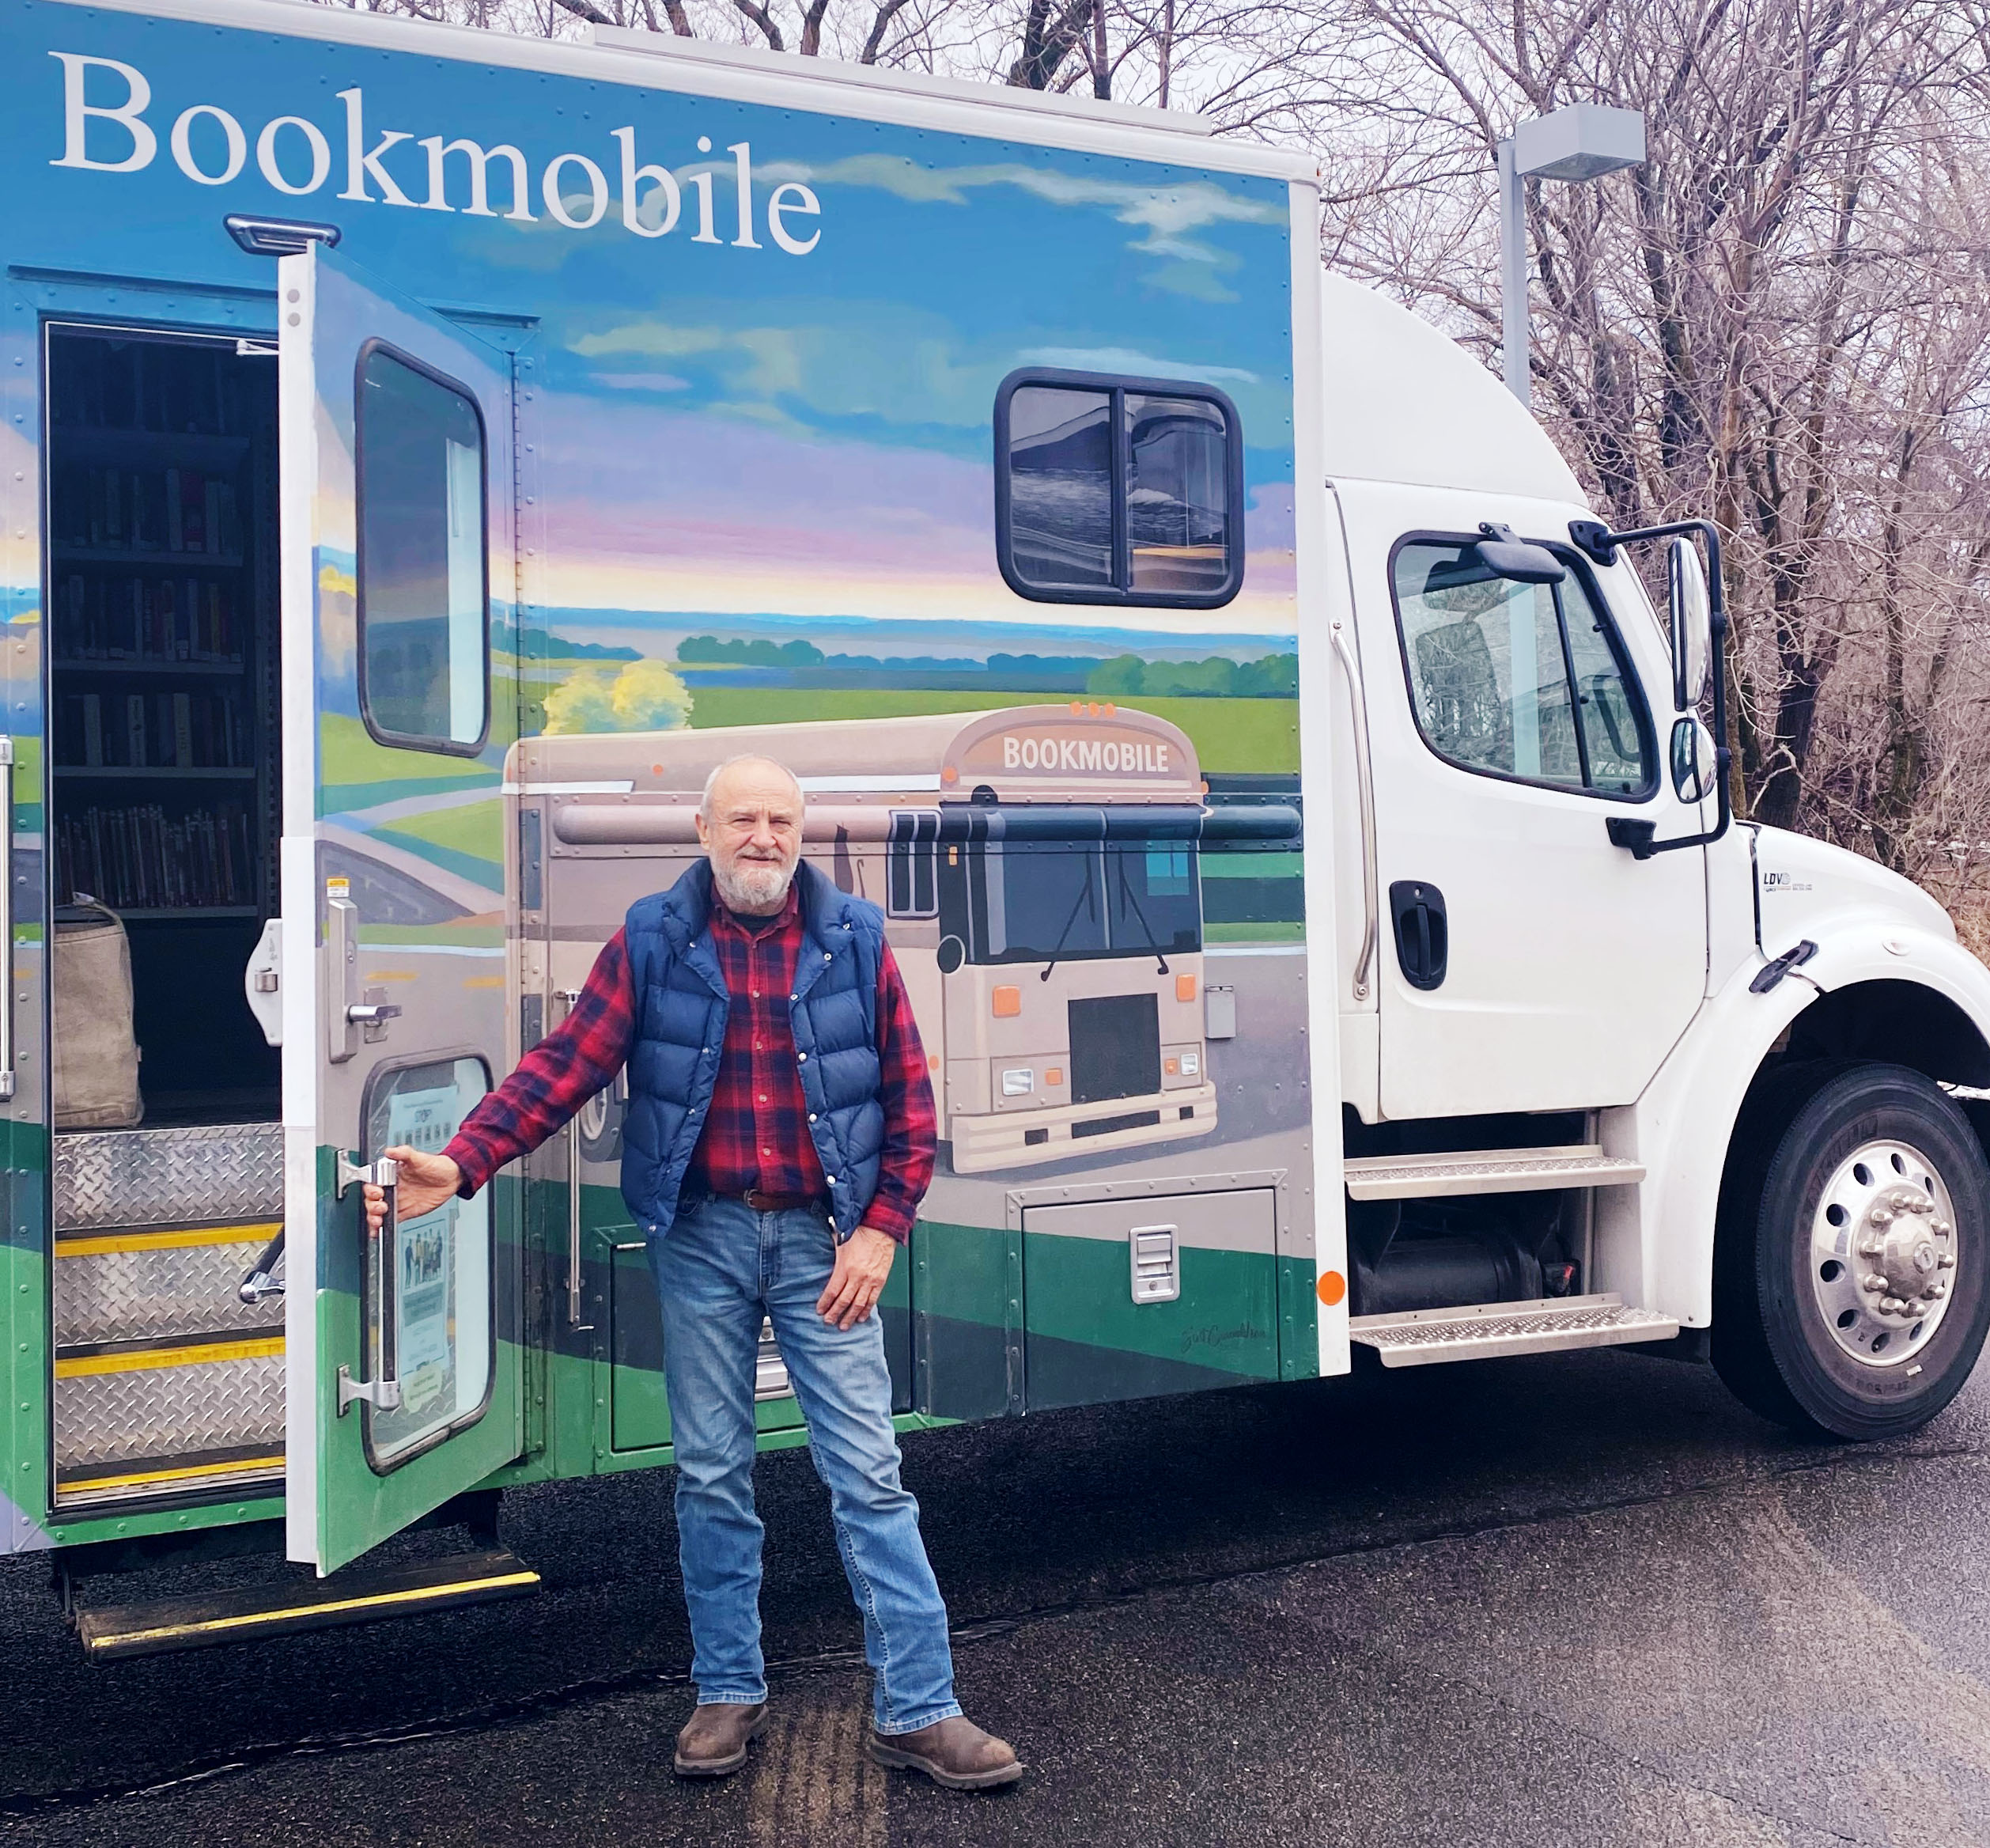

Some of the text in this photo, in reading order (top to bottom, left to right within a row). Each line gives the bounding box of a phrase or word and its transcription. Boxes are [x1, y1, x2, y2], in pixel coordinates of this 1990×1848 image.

[48, 51, 822, 256] Bookmobile
[1004, 737, 1169, 772] BOOKMOBILE
[1764, 873, 1783, 884] LDV
